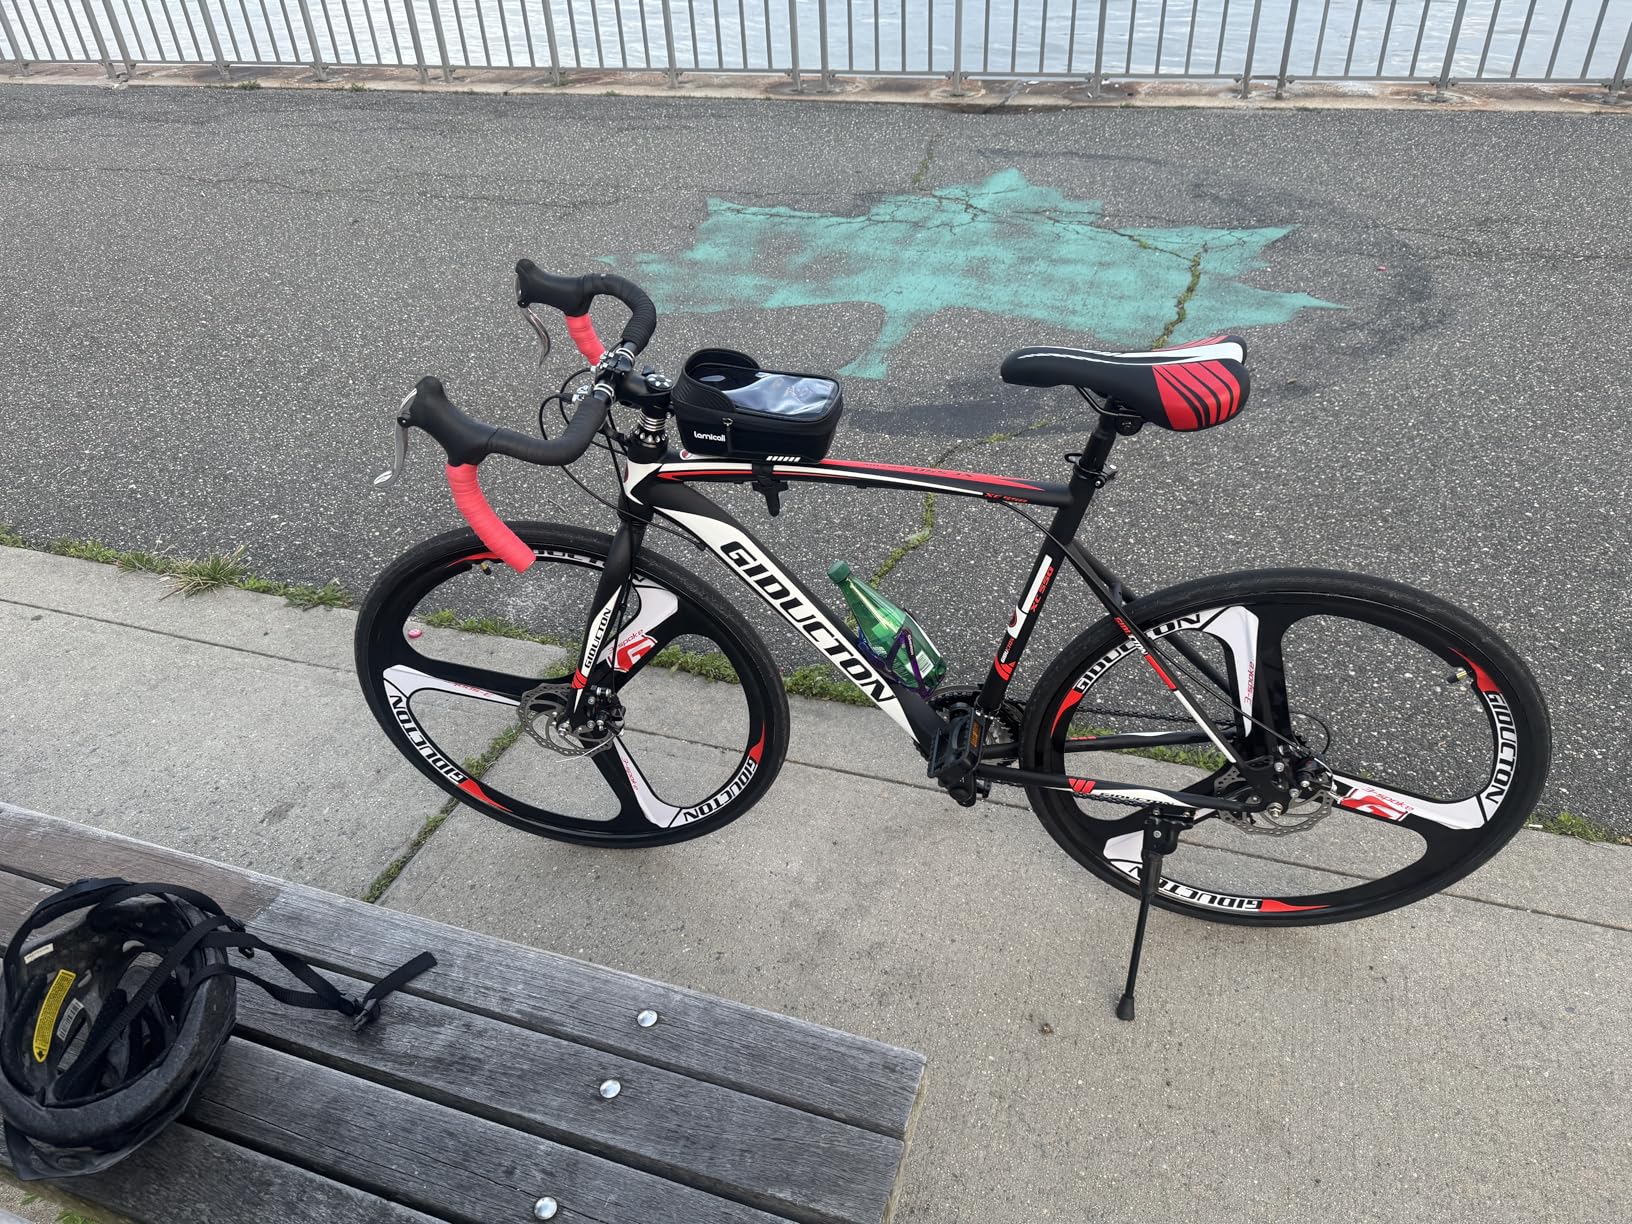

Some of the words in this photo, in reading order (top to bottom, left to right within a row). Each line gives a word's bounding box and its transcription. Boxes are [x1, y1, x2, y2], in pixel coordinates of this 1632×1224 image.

[584, 607, 611, 668] GIDUCTON
[720, 541, 897, 702] GIDUCTON
[389, 695, 468, 783] GIDUCTON
[1485, 691, 1516, 804] GIDUCTON
[683, 757, 757, 822] GIDUCTON
